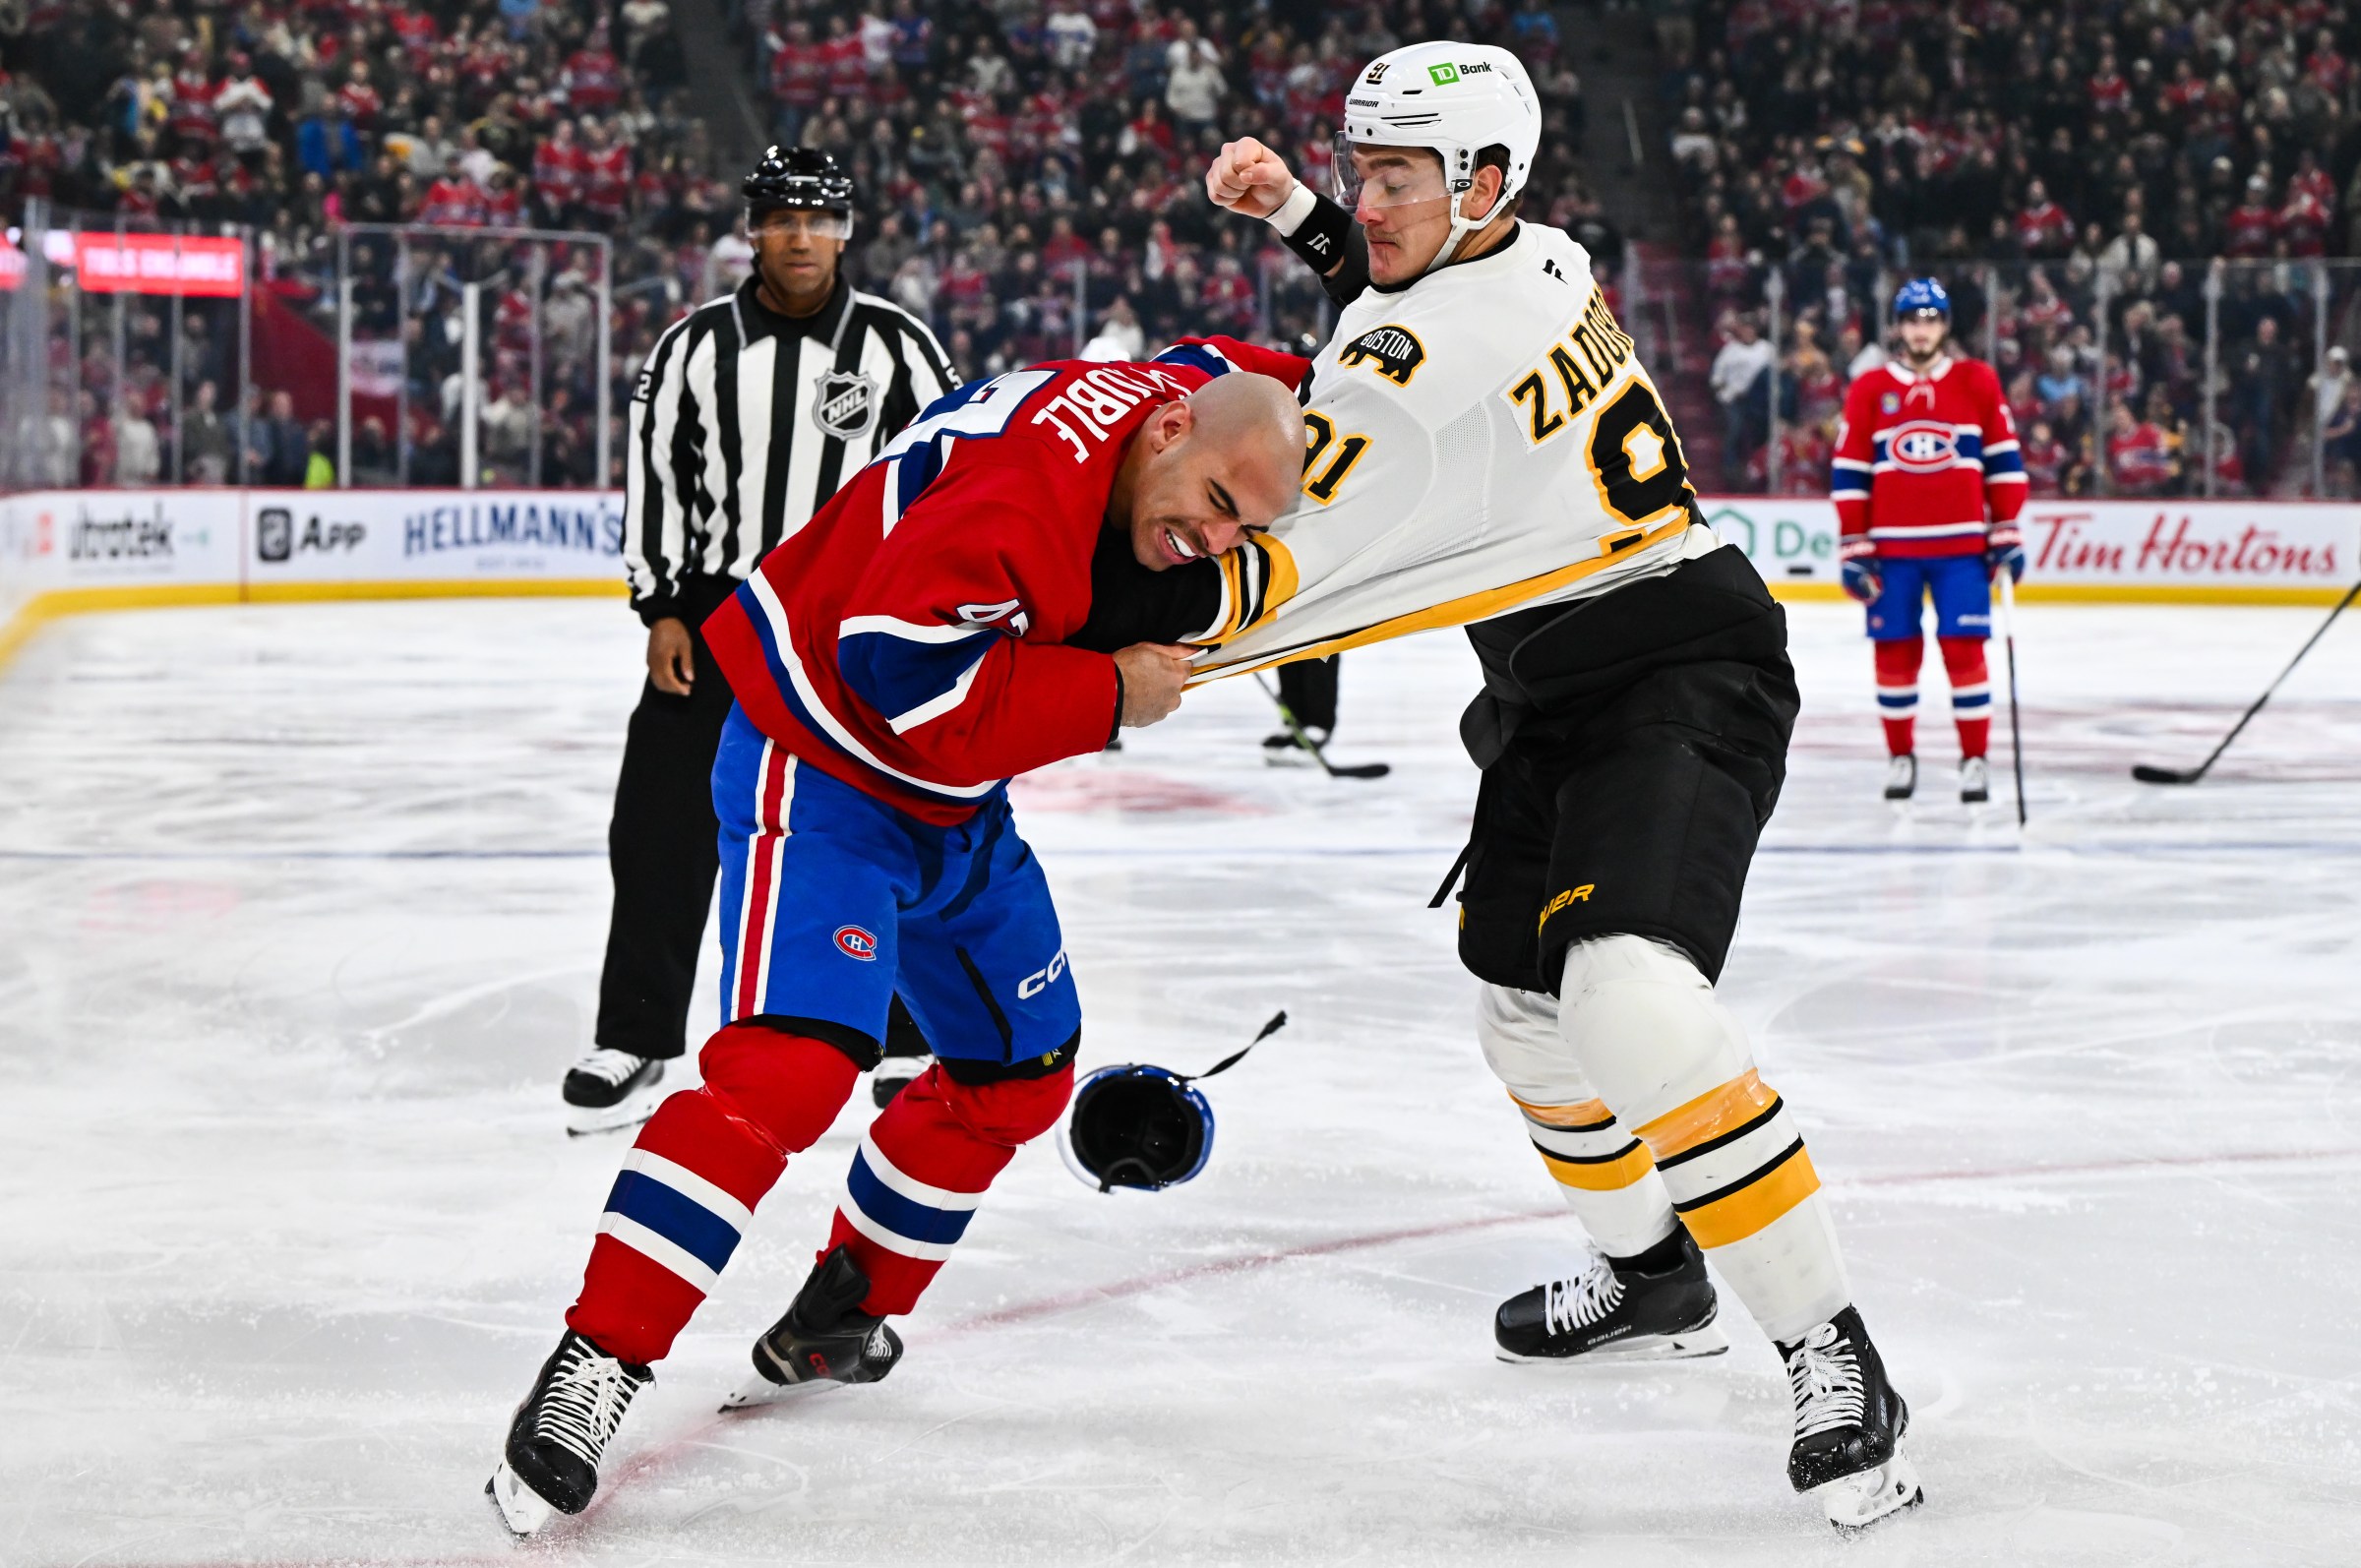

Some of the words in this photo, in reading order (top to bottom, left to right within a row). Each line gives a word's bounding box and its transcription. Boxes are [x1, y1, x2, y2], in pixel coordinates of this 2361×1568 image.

[1366, 62, 1391, 80] 91
[1431, 66, 1453, 81] TD
[1459, 61, 1492, 75] Bank
[1360, 330, 1414, 361] BOSTON
[827, 389, 867, 423] NHL
[404, 497, 623, 561] HELLMANN'S
[2032, 513, 2123, 572] Tim
[2136, 513, 2338, 573] Hortons
[1017, 948, 1067, 999] CC
